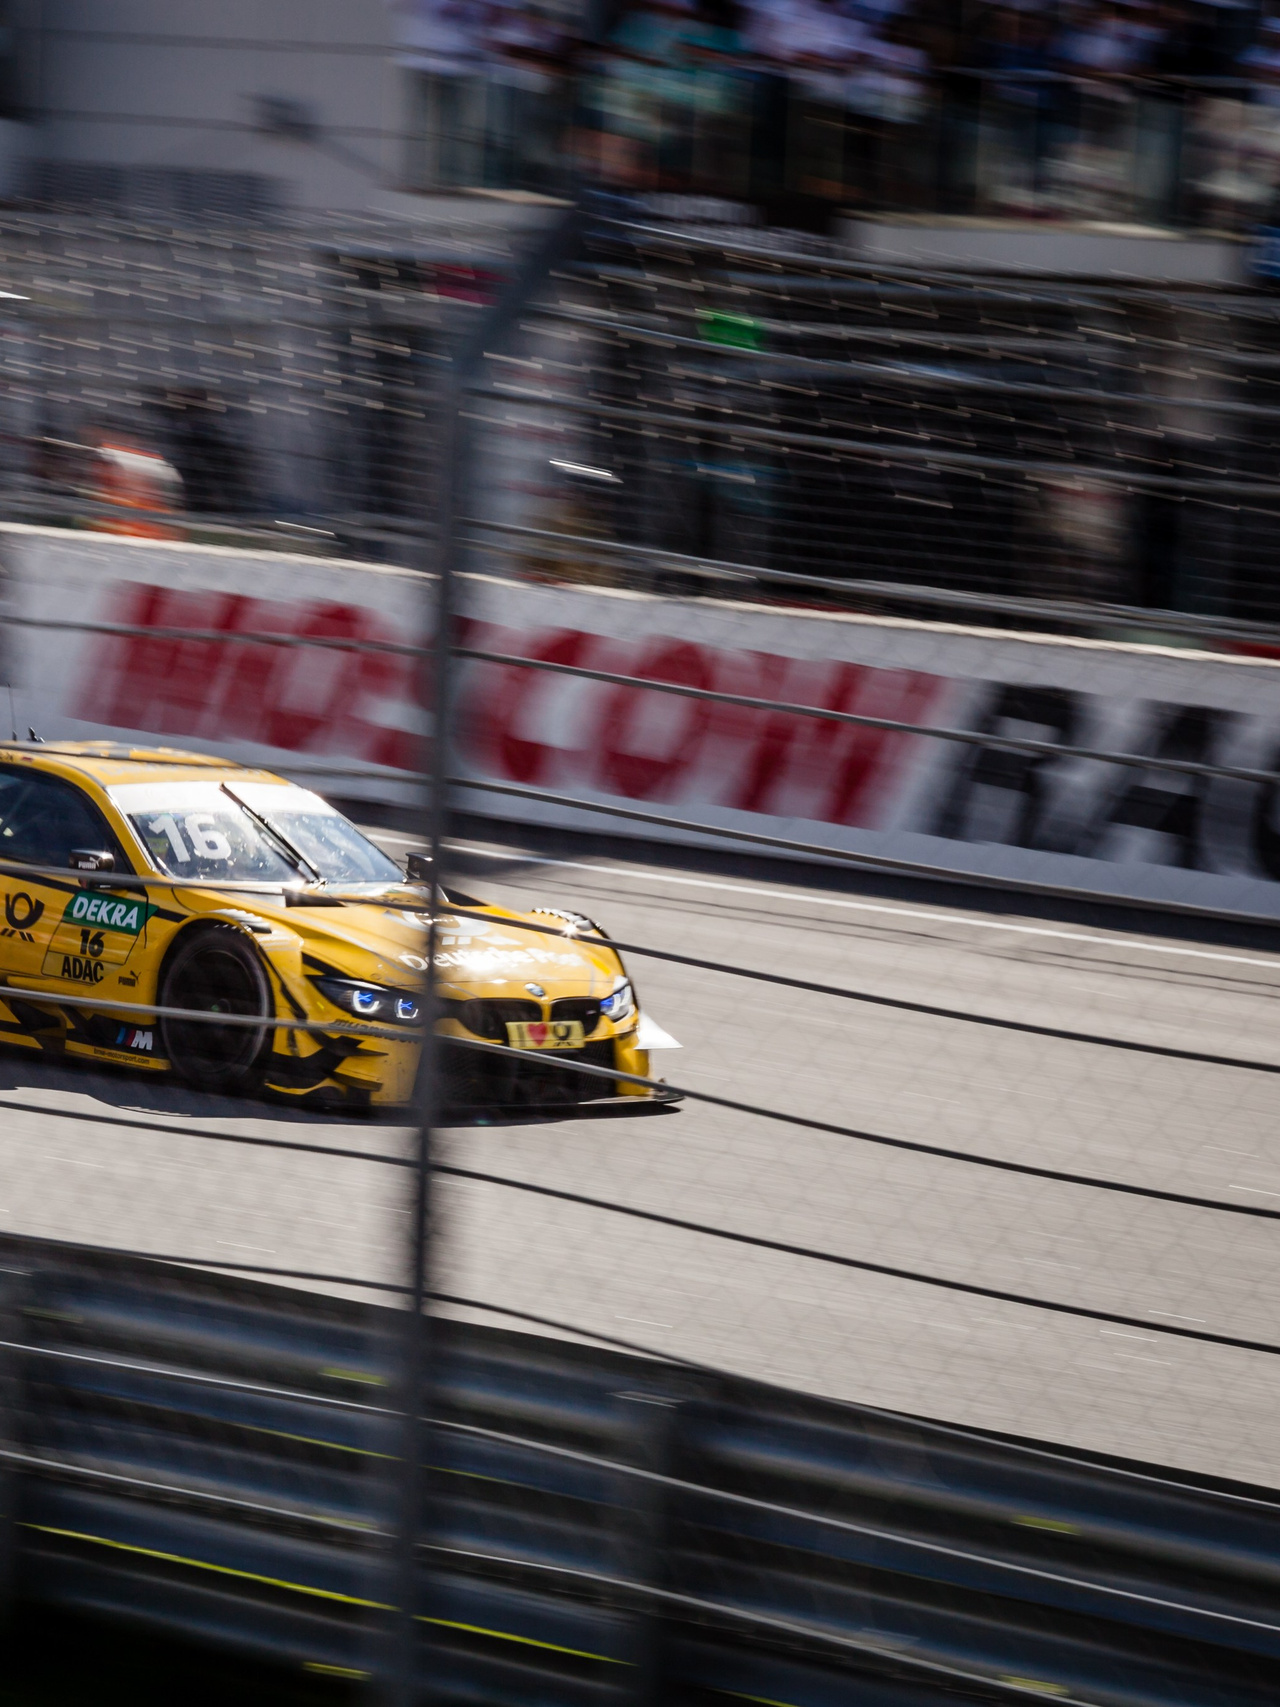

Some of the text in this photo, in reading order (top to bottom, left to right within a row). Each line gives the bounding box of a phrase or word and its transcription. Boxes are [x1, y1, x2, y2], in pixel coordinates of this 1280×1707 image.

[918, 678, 1280, 882] RA
[148, 813, 232, 863] 16
[72, 896, 140, 930] DEKRA
[79, 928, 107, 958] 16
[61, 955, 105, 984] ADAC
